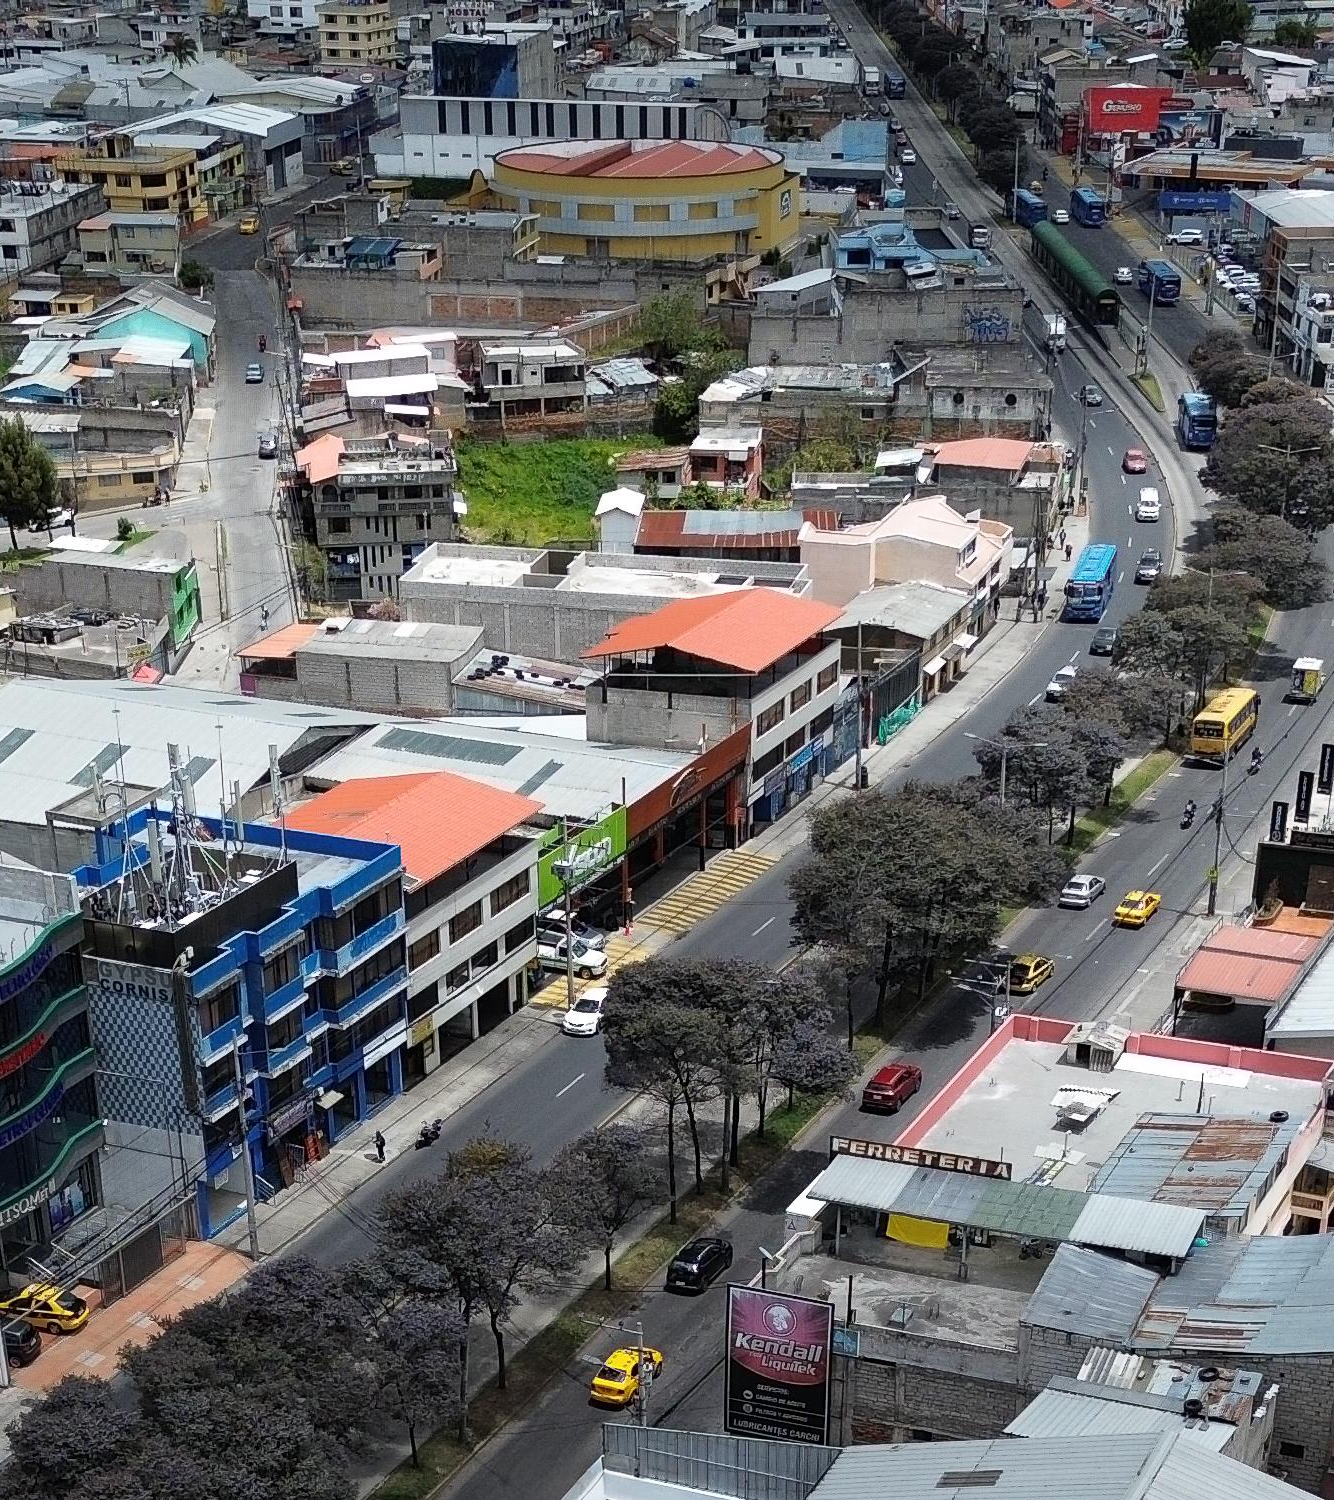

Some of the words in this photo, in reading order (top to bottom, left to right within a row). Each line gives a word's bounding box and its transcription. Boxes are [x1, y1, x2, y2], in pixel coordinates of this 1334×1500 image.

[448, 8, 489, 17] HOSTAL
[99, 961, 172, 987] GYPSU
[100, 978, 173, 1001] CORNIS
[831, 1137, 1010, 1179] FERRETERIA
[735, 1332, 823, 1363] Kendall
[733, 1418, 788, 1436] LUBRICANTES
